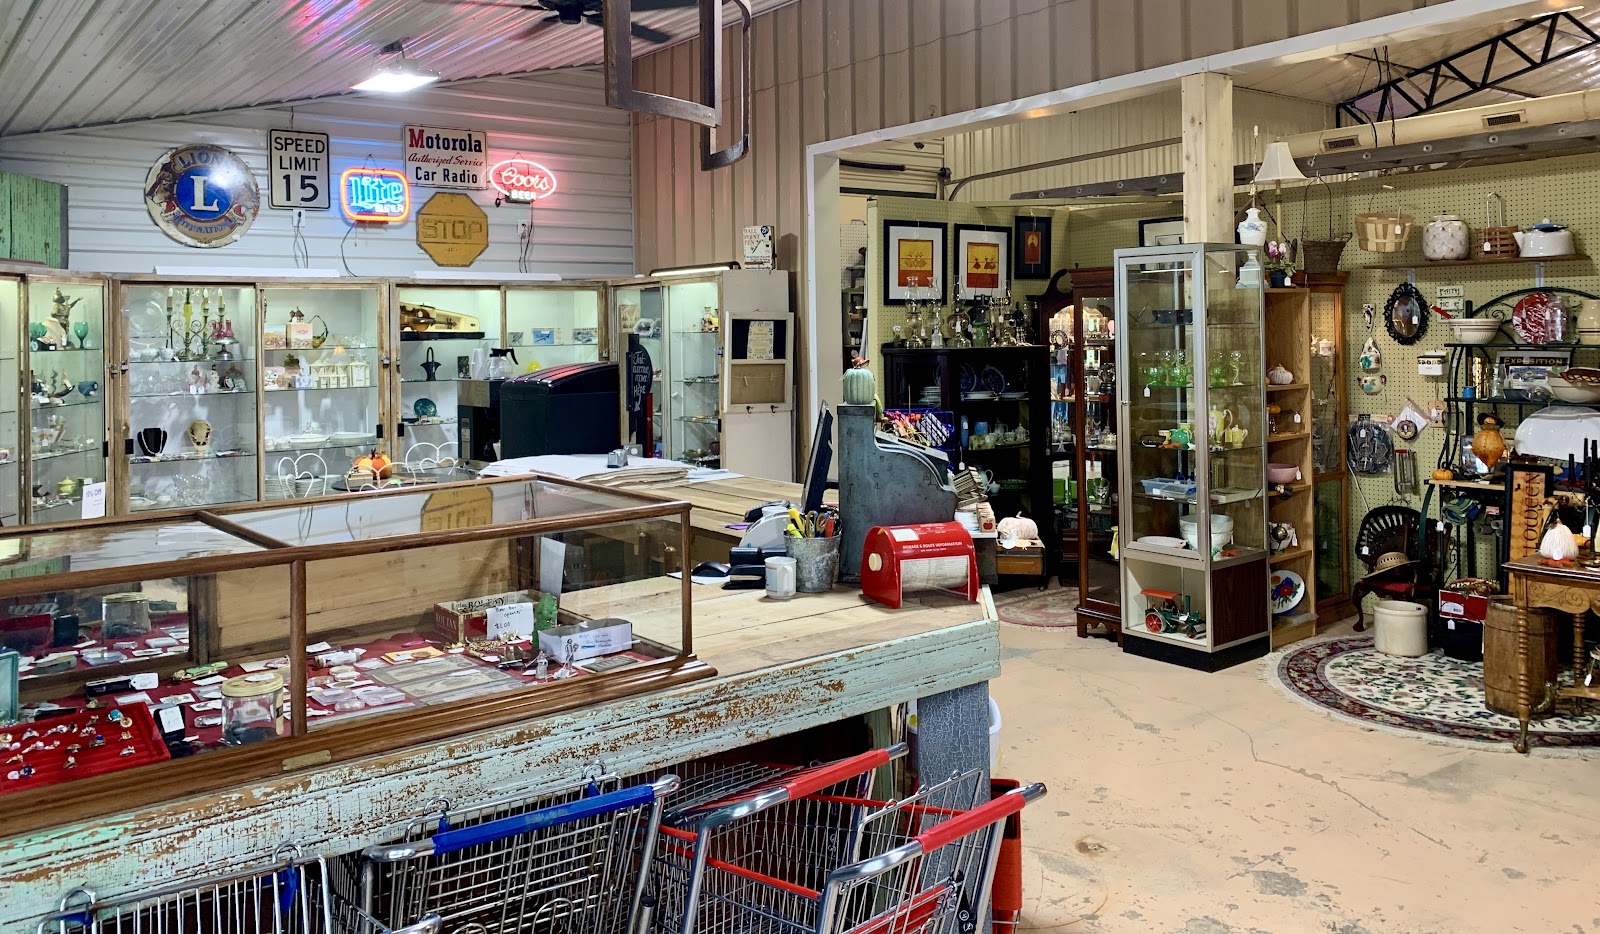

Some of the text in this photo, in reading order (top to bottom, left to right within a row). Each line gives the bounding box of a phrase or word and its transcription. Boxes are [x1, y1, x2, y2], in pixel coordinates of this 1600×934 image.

[274, 136, 325, 153] SPEED
[408, 128, 482, 153] Motorola
[279, 155, 321, 171] LIMIT
[408, 153, 483, 167] Authorized Service
[415, 166, 478, 184] Car Radio
[501, 167, 551, 190] Coors
[190, 175, 220, 212] L
[283, 174, 319, 202] 15
[348, 176, 403, 209] Lite
[511, 189, 537, 200] BEER
[422, 217, 483, 239] STOP
[1503, 357, 1563, 365] EXPSITION
